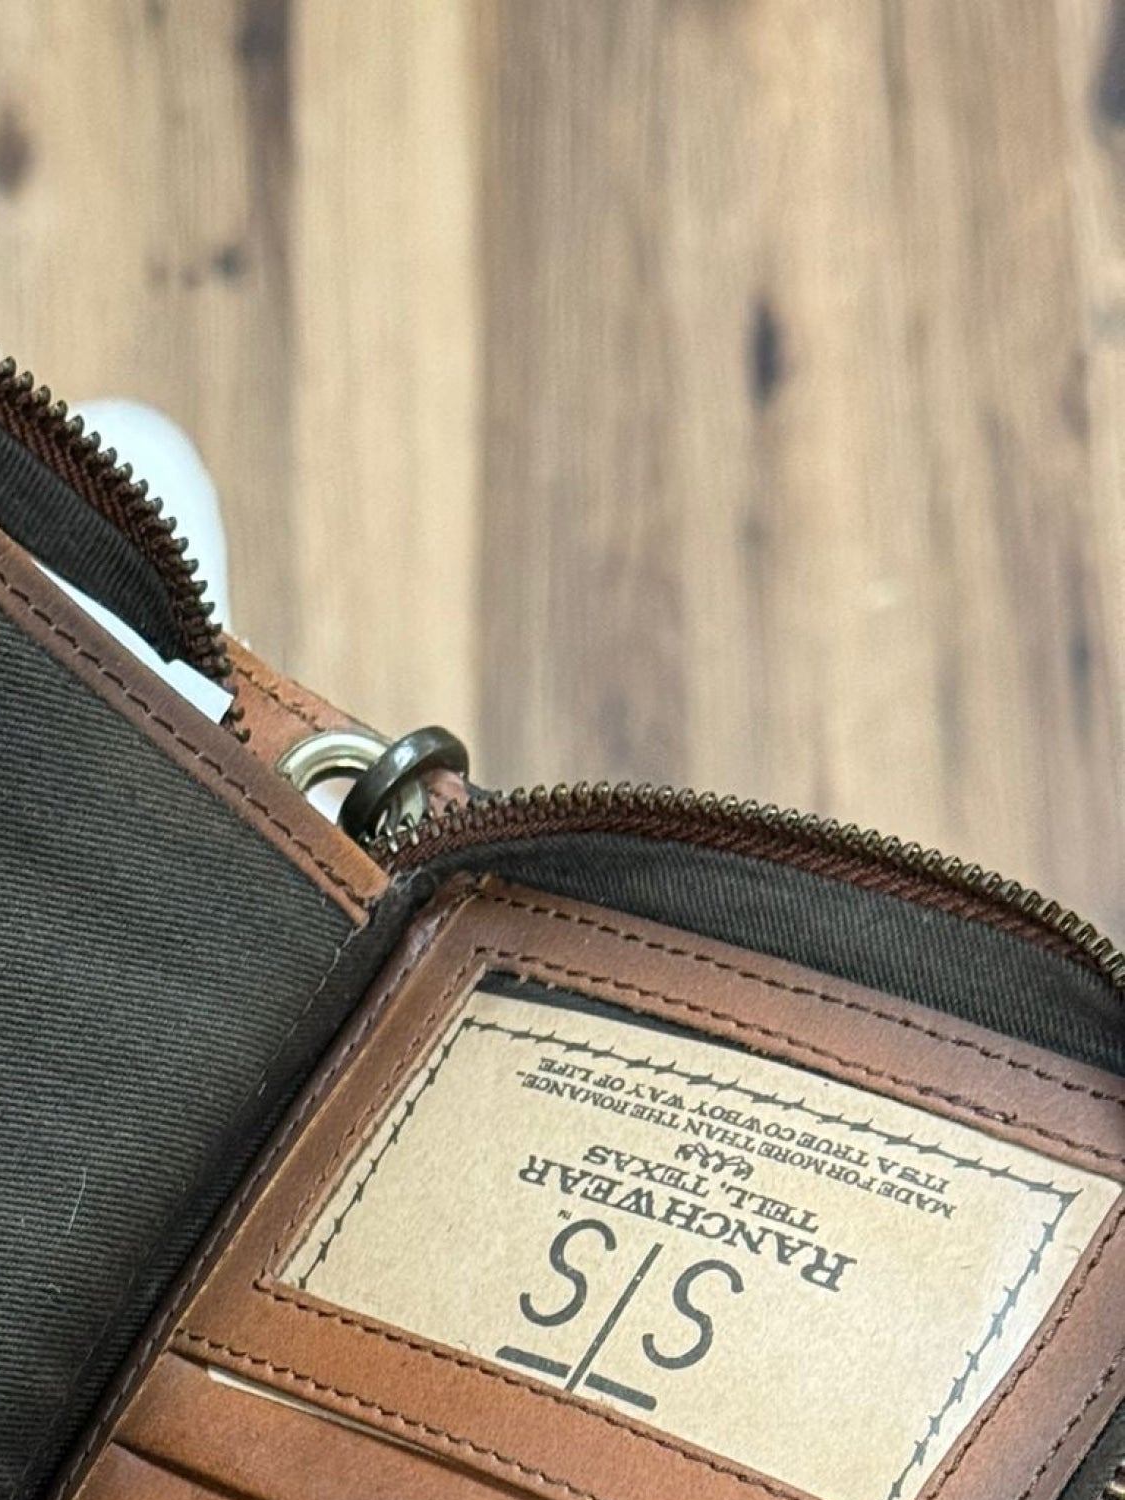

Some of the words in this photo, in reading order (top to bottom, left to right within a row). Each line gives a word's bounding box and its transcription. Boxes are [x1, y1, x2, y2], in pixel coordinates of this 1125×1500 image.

[537, 1056, 595, 1083] LIFE
[592, 1074, 625, 1092] OF
[625, 1083, 687, 1111] WAY
[629, 1102, 681, 1129] THE
[688, 1100, 796, 1142] COWBOY
[682, 1117, 757, 1152] THAN
[796, 1131, 870, 1168] TRUE
[582, 1144, 710, 1198] TEXAS
[756, 1141, 834, 1176] MORE
[824, 1161, 878, 1192] FOR
[876, 1180, 958, 1220] MADE
[518, 1154, 858, 1293] RANCHWEAR
